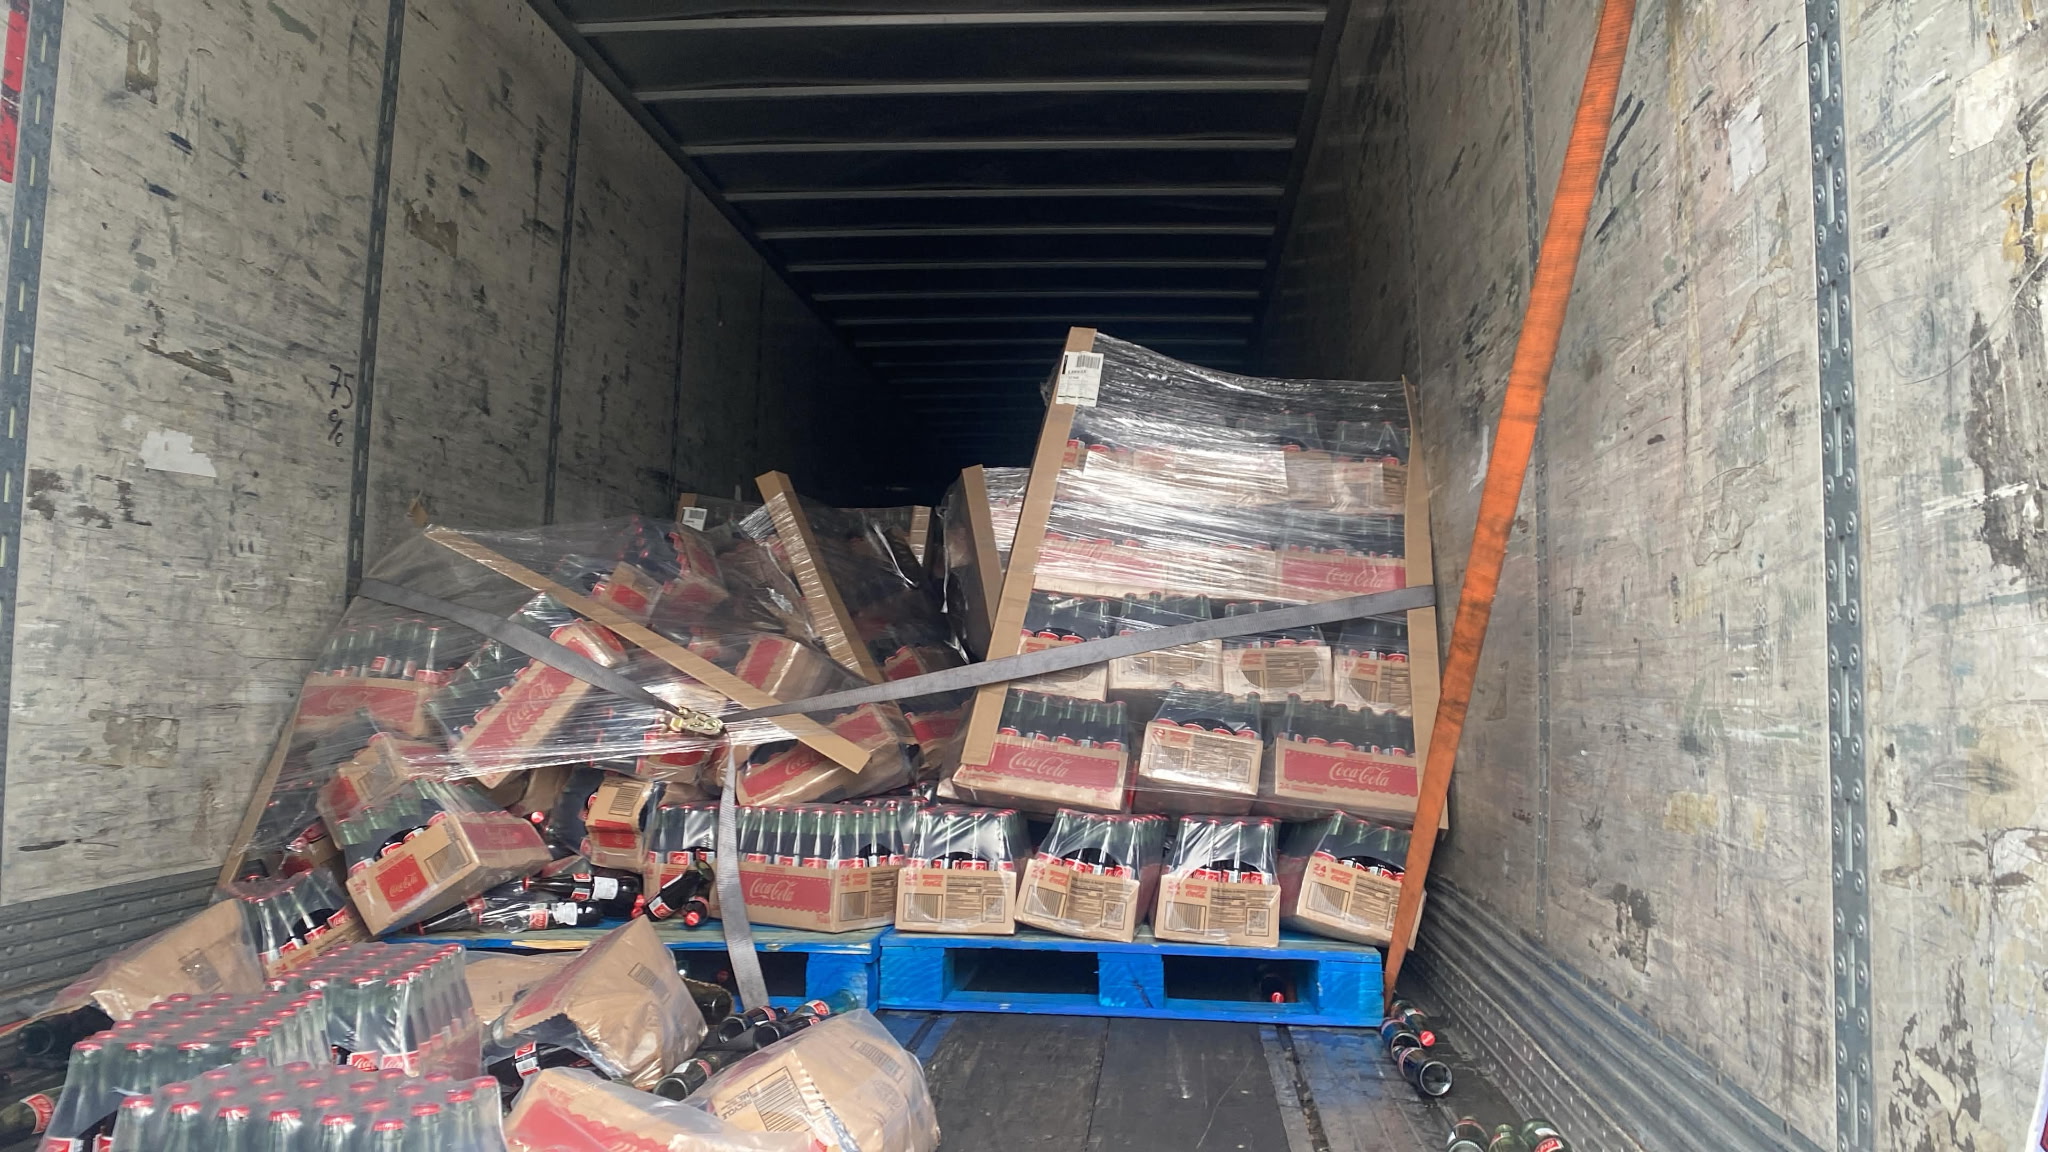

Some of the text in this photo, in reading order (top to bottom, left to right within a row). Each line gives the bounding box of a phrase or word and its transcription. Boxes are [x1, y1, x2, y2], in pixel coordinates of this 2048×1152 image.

[328, 364, 355, 410] 75
[1008, 750, 1074, 778] Coca-Cola
[1329, 761, 1391, 787] Coca-Cola
[749, 877, 799, 902] Coca-Cola
